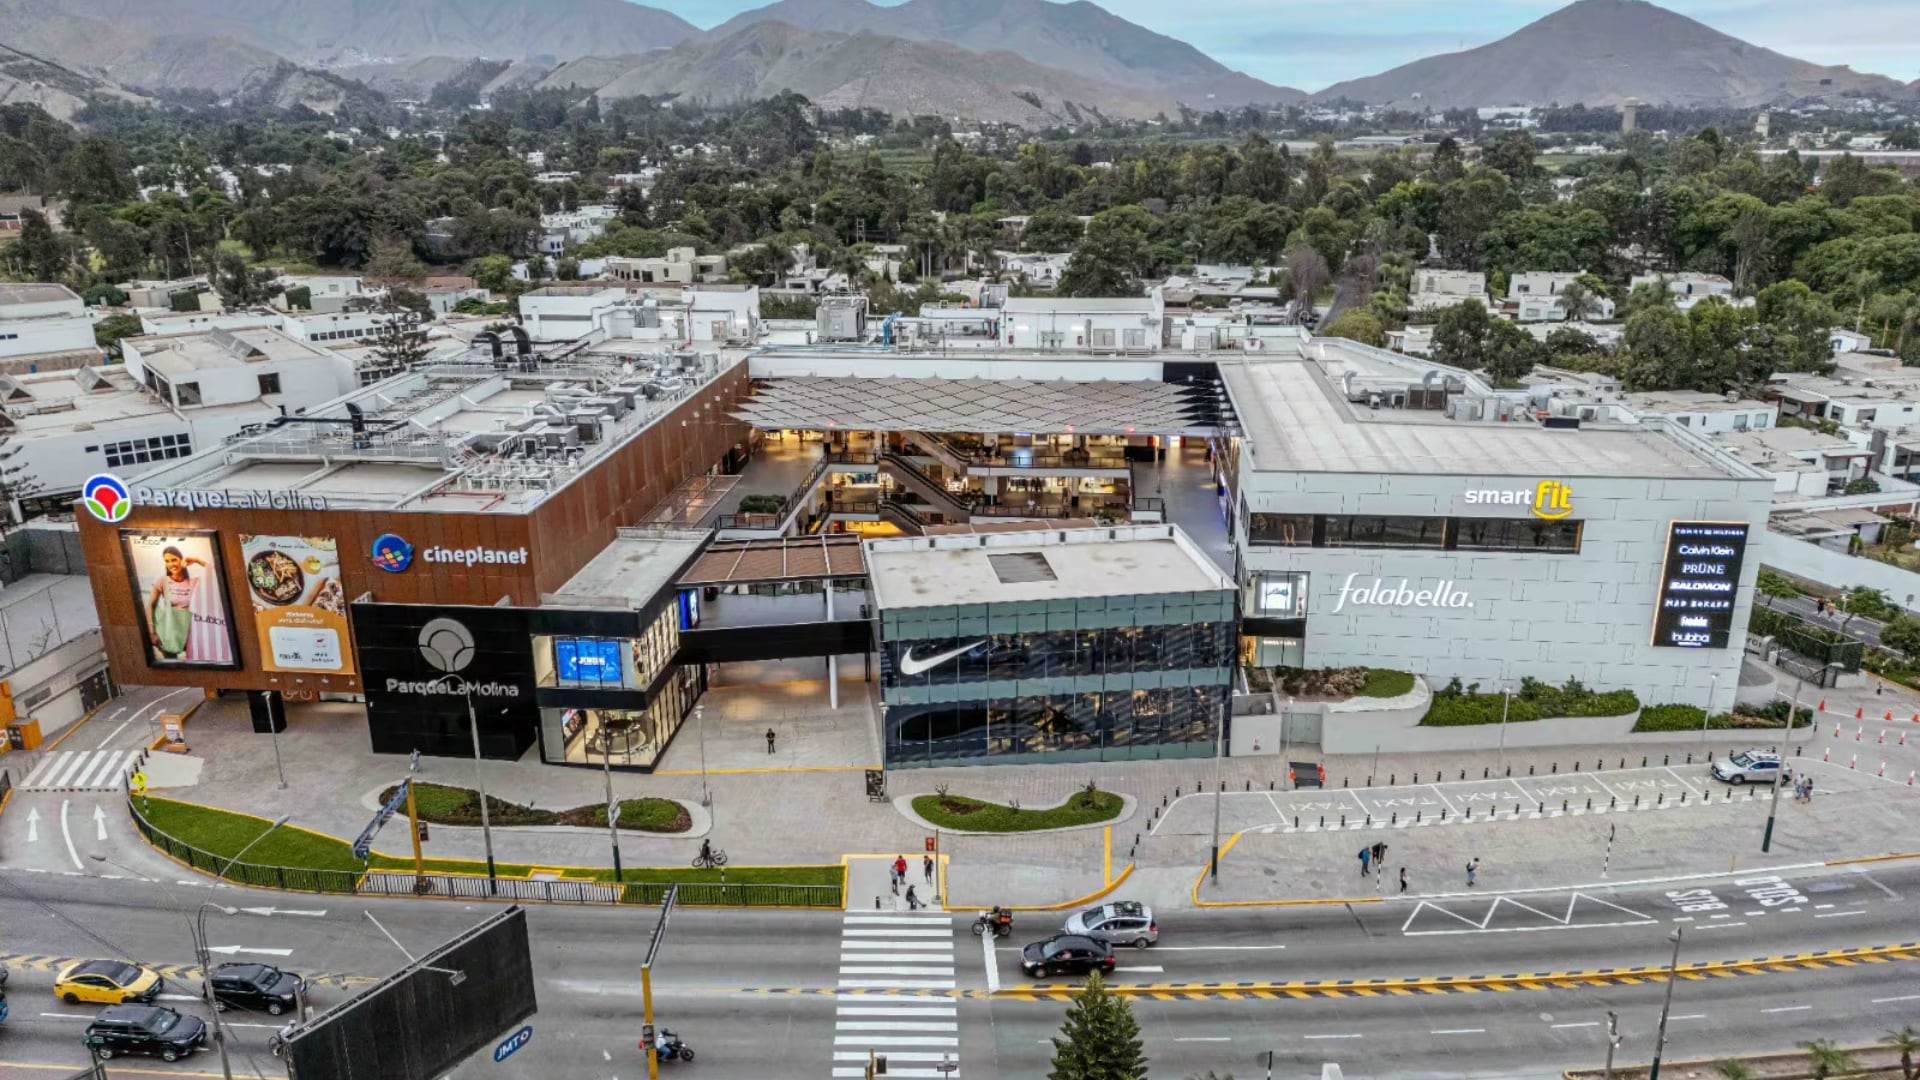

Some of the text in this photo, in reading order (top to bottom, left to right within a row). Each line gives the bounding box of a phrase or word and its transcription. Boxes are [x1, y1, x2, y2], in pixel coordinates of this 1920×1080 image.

[1464, 480, 1573, 510] smart fit
[423, 545, 528, 567] cineplanet
[1679, 545, 1734, 556] Calvin Klein
[1682, 562, 1726, 574] PRÜNE
[1669, 581, 1731, 591] SALOMON
[1665, 599, 1688, 608] MAD
[1671, 632, 1710, 642] bubba
[1616, 779, 1679, 791] TAXI
[1456, 791, 1519, 802] TAXI
[1536, 785, 1600, 797] TAXI
[1290, 802, 1353, 811] TAXI
[1373, 797, 1437, 808] TAXI
[497, 1030, 529, 1060] JMTO
